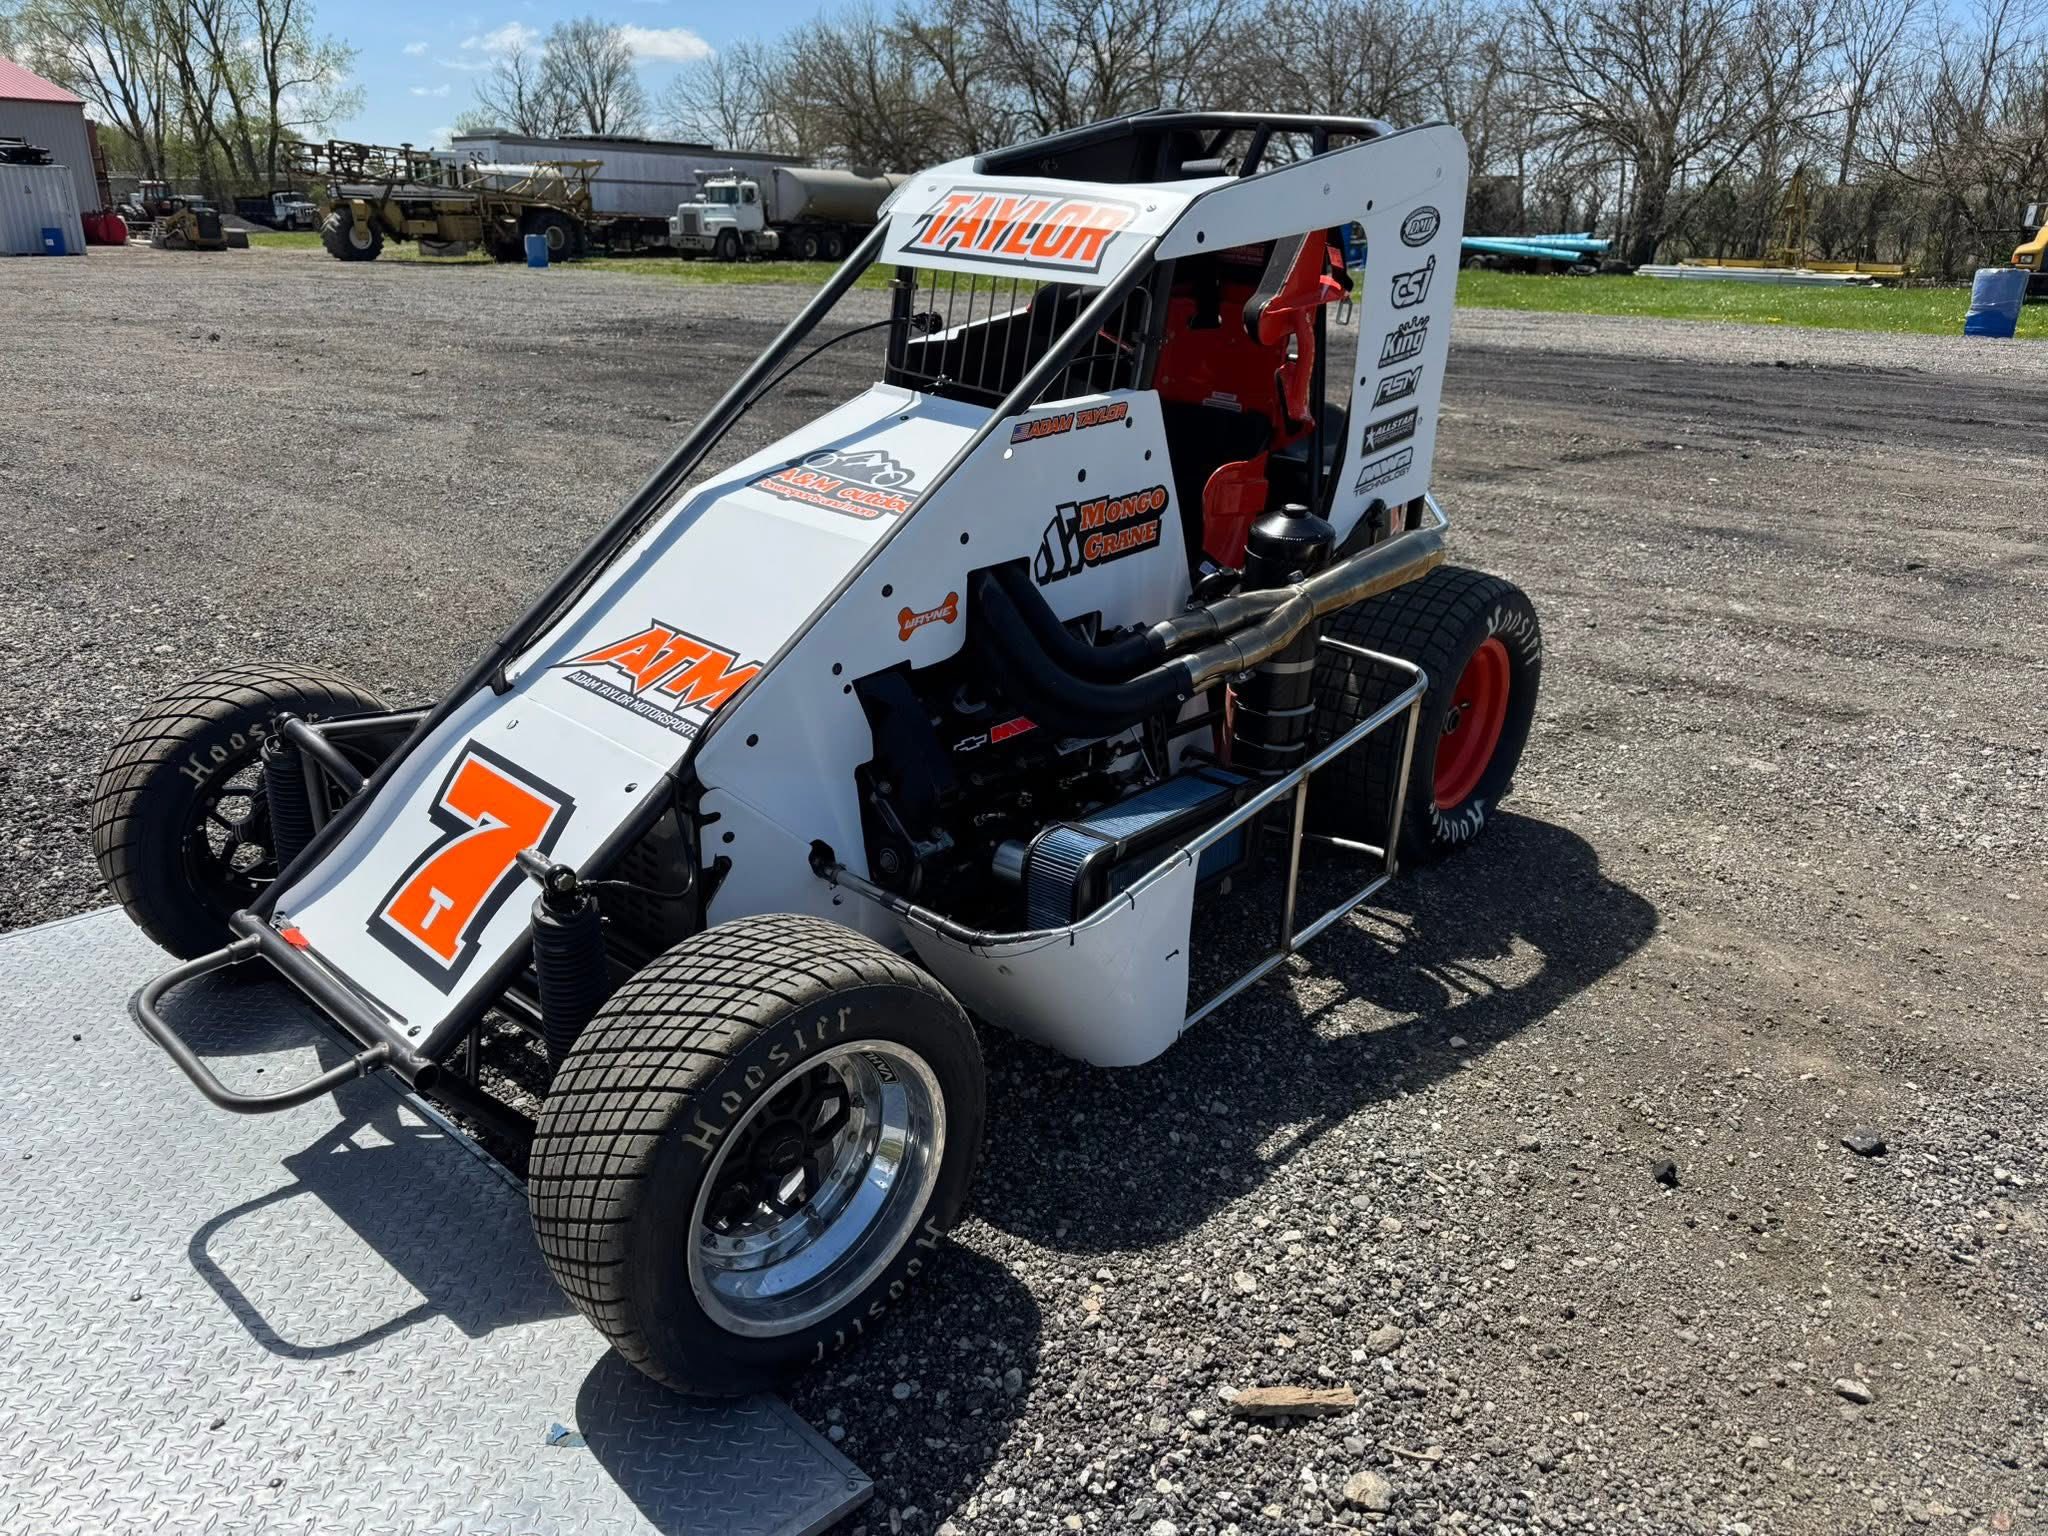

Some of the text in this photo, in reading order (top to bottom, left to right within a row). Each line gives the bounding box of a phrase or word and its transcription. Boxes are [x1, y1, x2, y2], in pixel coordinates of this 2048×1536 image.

[912, 191, 1134, 266] TAYLOR
[1029, 402, 1128, 438] ADAM TAYLOR
[1375, 413, 1415, 435] ALLSTAR
[774, 467, 842, 494] A&M
[1353, 466, 1412, 496] TECHNOLOGY
[903, 605, 953, 630] WAYNE
[566, 621, 764, 712] ATM
[567, 671, 598, 691] ADAM
[597, 682, 633, 706] TAYLOR
[378, 748, 566, 976] 7
[421, 886, 455, 931] T
